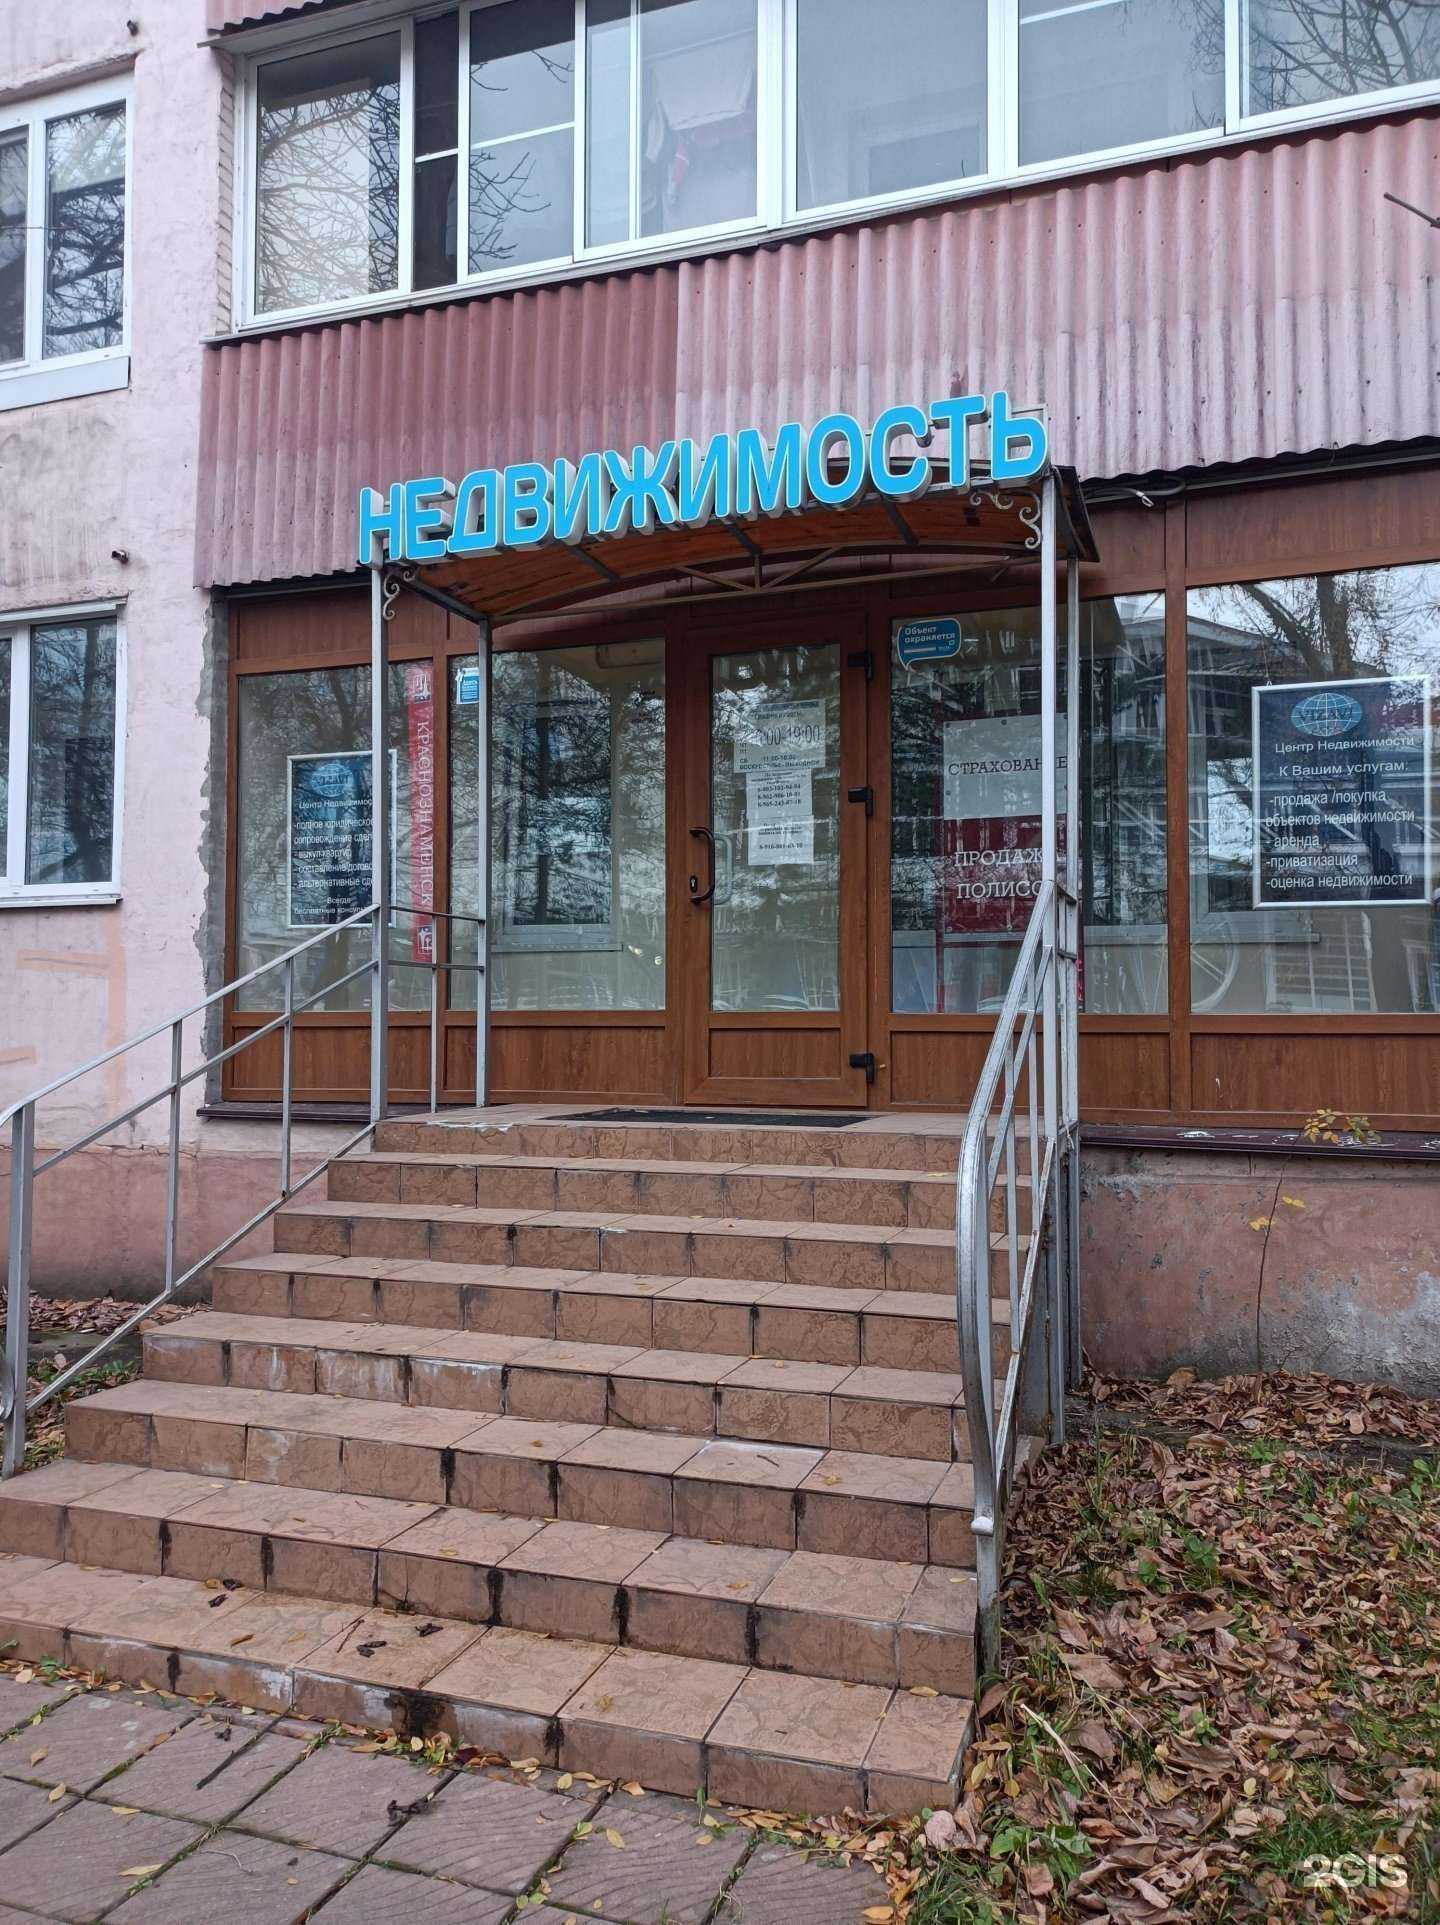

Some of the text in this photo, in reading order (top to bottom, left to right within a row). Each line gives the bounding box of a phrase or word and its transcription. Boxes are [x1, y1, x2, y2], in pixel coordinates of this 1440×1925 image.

[358, 390, 1048, 565] НЕДВИЖИМОСТЬ
[904, 626, 937, 636] Объект
[904, 632, 956, 644] охраняется
[1275, 737, 1415, 755] Центр Недвижимости
[949, 756, 1068, 776] СТРАХОВАНЕ
[1279, 761, 1409, 777] К Вашим услугам:
[1265, 810, 1415, 828] объектов недвижимости
[1274, 834, 1321, 849] аренда
[1318, 874, 1414, 889] недвижимости
